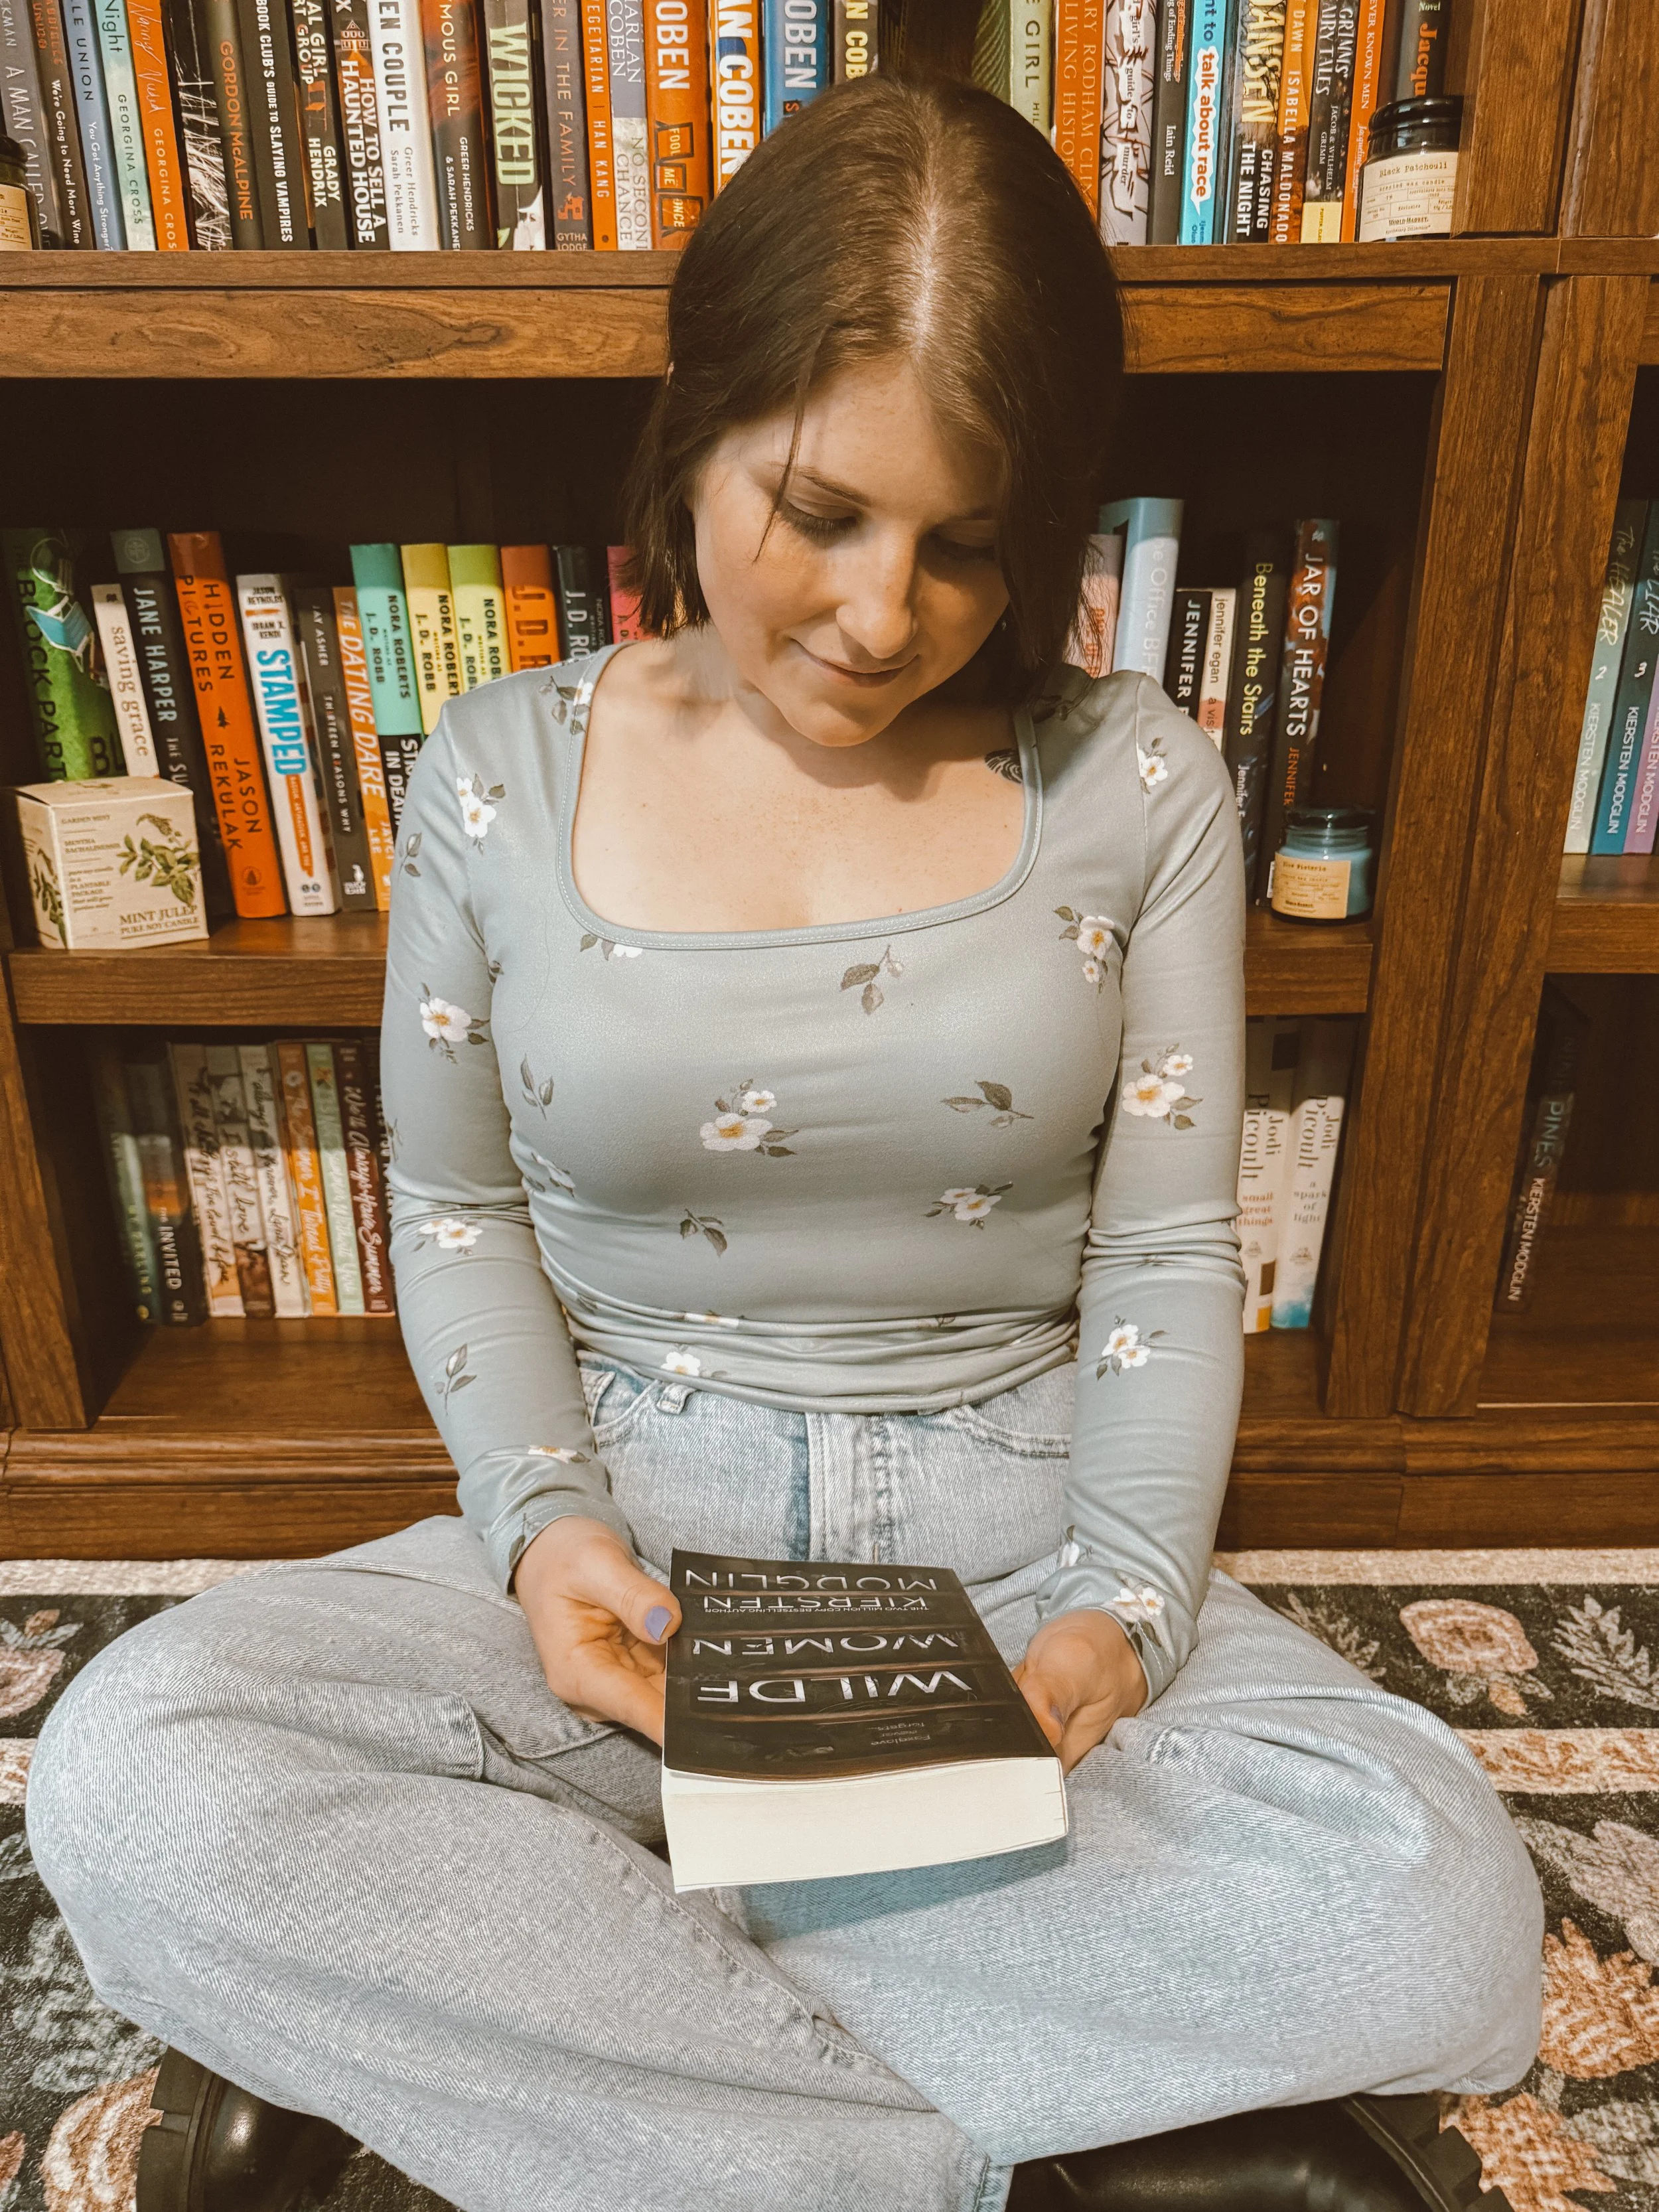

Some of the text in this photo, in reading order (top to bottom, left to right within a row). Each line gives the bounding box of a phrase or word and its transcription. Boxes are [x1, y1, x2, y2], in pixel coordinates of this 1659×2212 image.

[610, 0, 626, 77] COBEN
[1418, 1, 1441, 11] Novel
[76, 38, 94, 100] UNION
[296, 23, 315, 84] GROUP
[310, 33, 328, 77] GIRL
[1025, 20, 1041, 88] GIRL
[1063, 3, 1078, 80] LIVING
[1315, 44, 1335, 96] TALES
[1360, 32, 1375, 109] KNOWN MEN
[5, 66, 34, 130] A MAN
[382, 42, 410, 132] COUPLE
[445, 71, 460, 117] GIRL
[489, 21, 535, 185] WICKED
[554, 29, 577, 186] IN THE FAMILY
[719, 55, 754, 175] COBEN
[1081, 44, 1097, 137] RODHAM
[1125, 68, 1135, 97] guide
[1196, 22, 1216, 198] to talk about race
[118, 94, 143, 224] GEORGINA CROSS
[220, 41, 253, 220] GORDON McALPINE
[259, 35, 293, 243] CLUB'S GUIDE TO SLAYING VAMPIRES
[341, 60, 376, 244] HAUNTED HOUSE
[360, 78, 384, 208] HOW TO SELL
[593, 120, 610, 198] HAN KANG
[632, 137, 645, 167] NO
[1164, 124, 1177, 177] Iain Reid
[1275, 10, 1305, 243] DAWN ISABELLA MALDONADO
[1326, 105, 1338, 190] JACOB WILHELM
[55, 111, 82, 244] Going to Need More Wine
[88, 121, 106, 205] You Got Anything
[154, 128, 172, 205] GEORGINA
[308, 137, 340, 207] GRADY HENDRIX
[390, 150, 405, 234] Sarah Pekkanen
[404, 147, 418, 236] Greer Hendricks
[447, 167, 457, 200] SARAH
[459, 137, 474, 232] GREER HENDRICKS
[616, 153, 632, 242] CHANCE
[1120, 147, 1130, 186] murder
[1236, 141, 1256, 237] THE NIGHT
[1256, 149, 1273, 230] CHASING
[1405, 161, 1447, 173] Patchouli
[557, 232, 587, 242] GYTHA
[179, 574, 214, 692] PICTURES
[315, 628, 329, 666] ASHER
[388, 595, 411, 699] NORA ROBERTS
[438, 595, 453, 635] NORA
[483, 599, 498, 640] NORA
[1177, 599, 1202, 700] JENNIFER
[1209, 598, 1228, 684] jennifer egan
[1285, 553, 1324, 737] JAR OF HEARTS
[134, 587, 178, 723] JANE HARPER
[372, 648, 386, 684] ROBB
[422, 652, 437, 693] ROBB
[1236, 562, 1273, 812] Beneath the Stairs Jennifer
[1595, 666, 1608, 680] 2
[1634, 661, 1648, 678] 3
[111, 626, 150, 757] saving grace
[256, 648, 307, 776] STAMPED
[339, 601, 386, 799] THE DATING DARE
[384, 750, 401, 769] IN
[1283, 747, 1301, 806] JENNIFER
[1569, 702, 1601, 830] KIERSTEN MODGLIN
[1606, 706, 1640, 834] KIERSTEN MODGLIN
[209, 744, 244, 850] REKULAK
[234, 757, 263, 834] JASON
[340, 808, 352, 833] WHY
[1635, 772, 1656, 834] MODGLIN
[368, 829, 382, 854] LEE
[119, 904, 198, 924] MINT JULEP
[1240, 1094, 1270, 1179] Picoult
[1265, 1115, 1284, 1155] Jodi
[1297, 1095, 1328, 1168] Picoult
[1320, 1114, 1340, 1149] Jodi
[1533, 1100, 1565, 1169] PINES
[1238, 1216, 1273, 1227] things
[1242, 1191, 1274, 1201] small
[1293, 1191, 1327, 1200] spark
[1303, 1202, 1317, 1211] of
[1524, 1177, 1546, 1241] KIERSTEN
[158, 1226, 182, 1290] INVITED
[1507, 1240, 1534, 1302] MODGLIN
[685, 1569, 938, 1593] MODGLIN
[703, 1595, 928, 1609] KIERSTEN
[693, 1633, 960, 1656] WOMEN
[697, 1670, 974, 1703] WILDE
